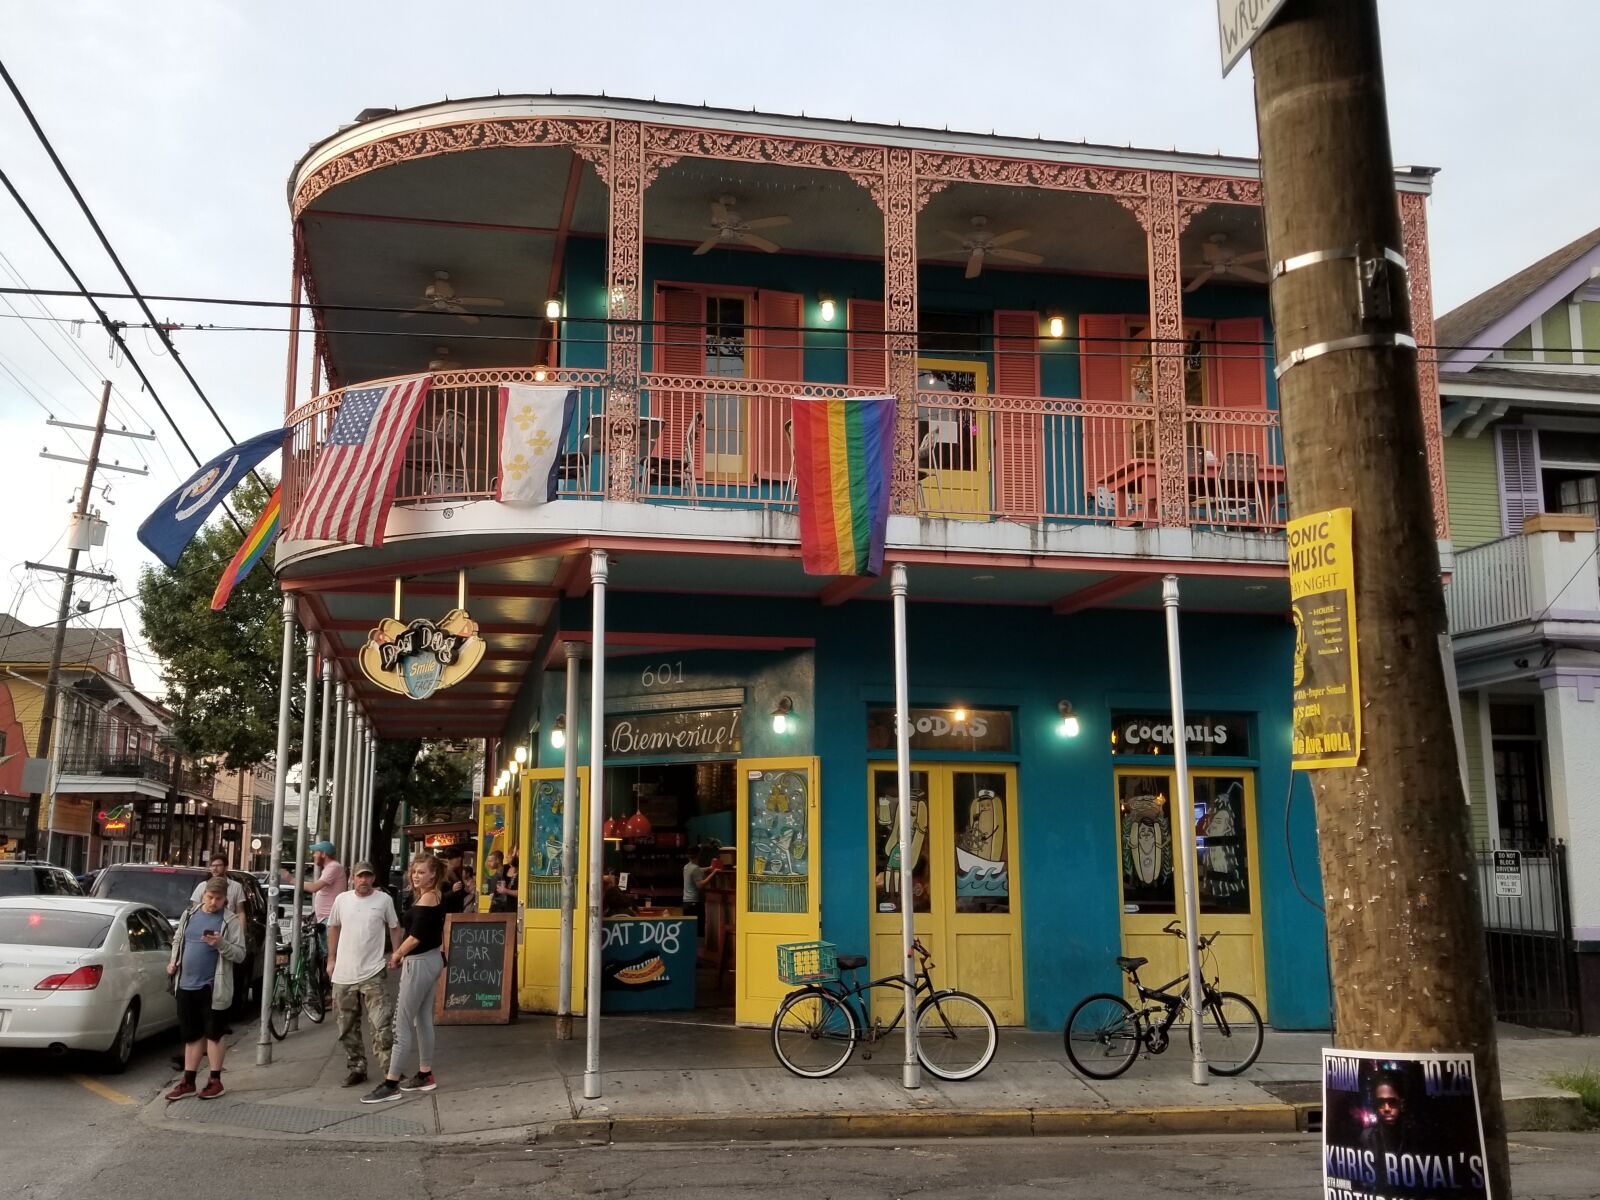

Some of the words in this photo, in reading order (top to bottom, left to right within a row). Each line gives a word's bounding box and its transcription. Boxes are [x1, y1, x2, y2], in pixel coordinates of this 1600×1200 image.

[1222, 0, 1270, 54] WRO
[1291, 542, 1336, 576] MUSIC
[1303, 572, 1339, 592] NIGHT
[409, 660, 437, 677] Smile
[641, 661, 684, 687] 601
[611, 716, 738, 753] Bienvenue!
[1125, 725, 1227, 744] COCKAILS
[452, 928, 504, 945] UPSTAIRS
[466, 946, 490, 960] BAR
[449, 966, 502, 987] BALCONY
[1325, 1056, 1360, 1092] FRIDAY
[1326, 1144, 1377, 1184] KHRIS
[1384, 1152, 1485, 1189] ROYAL'S
